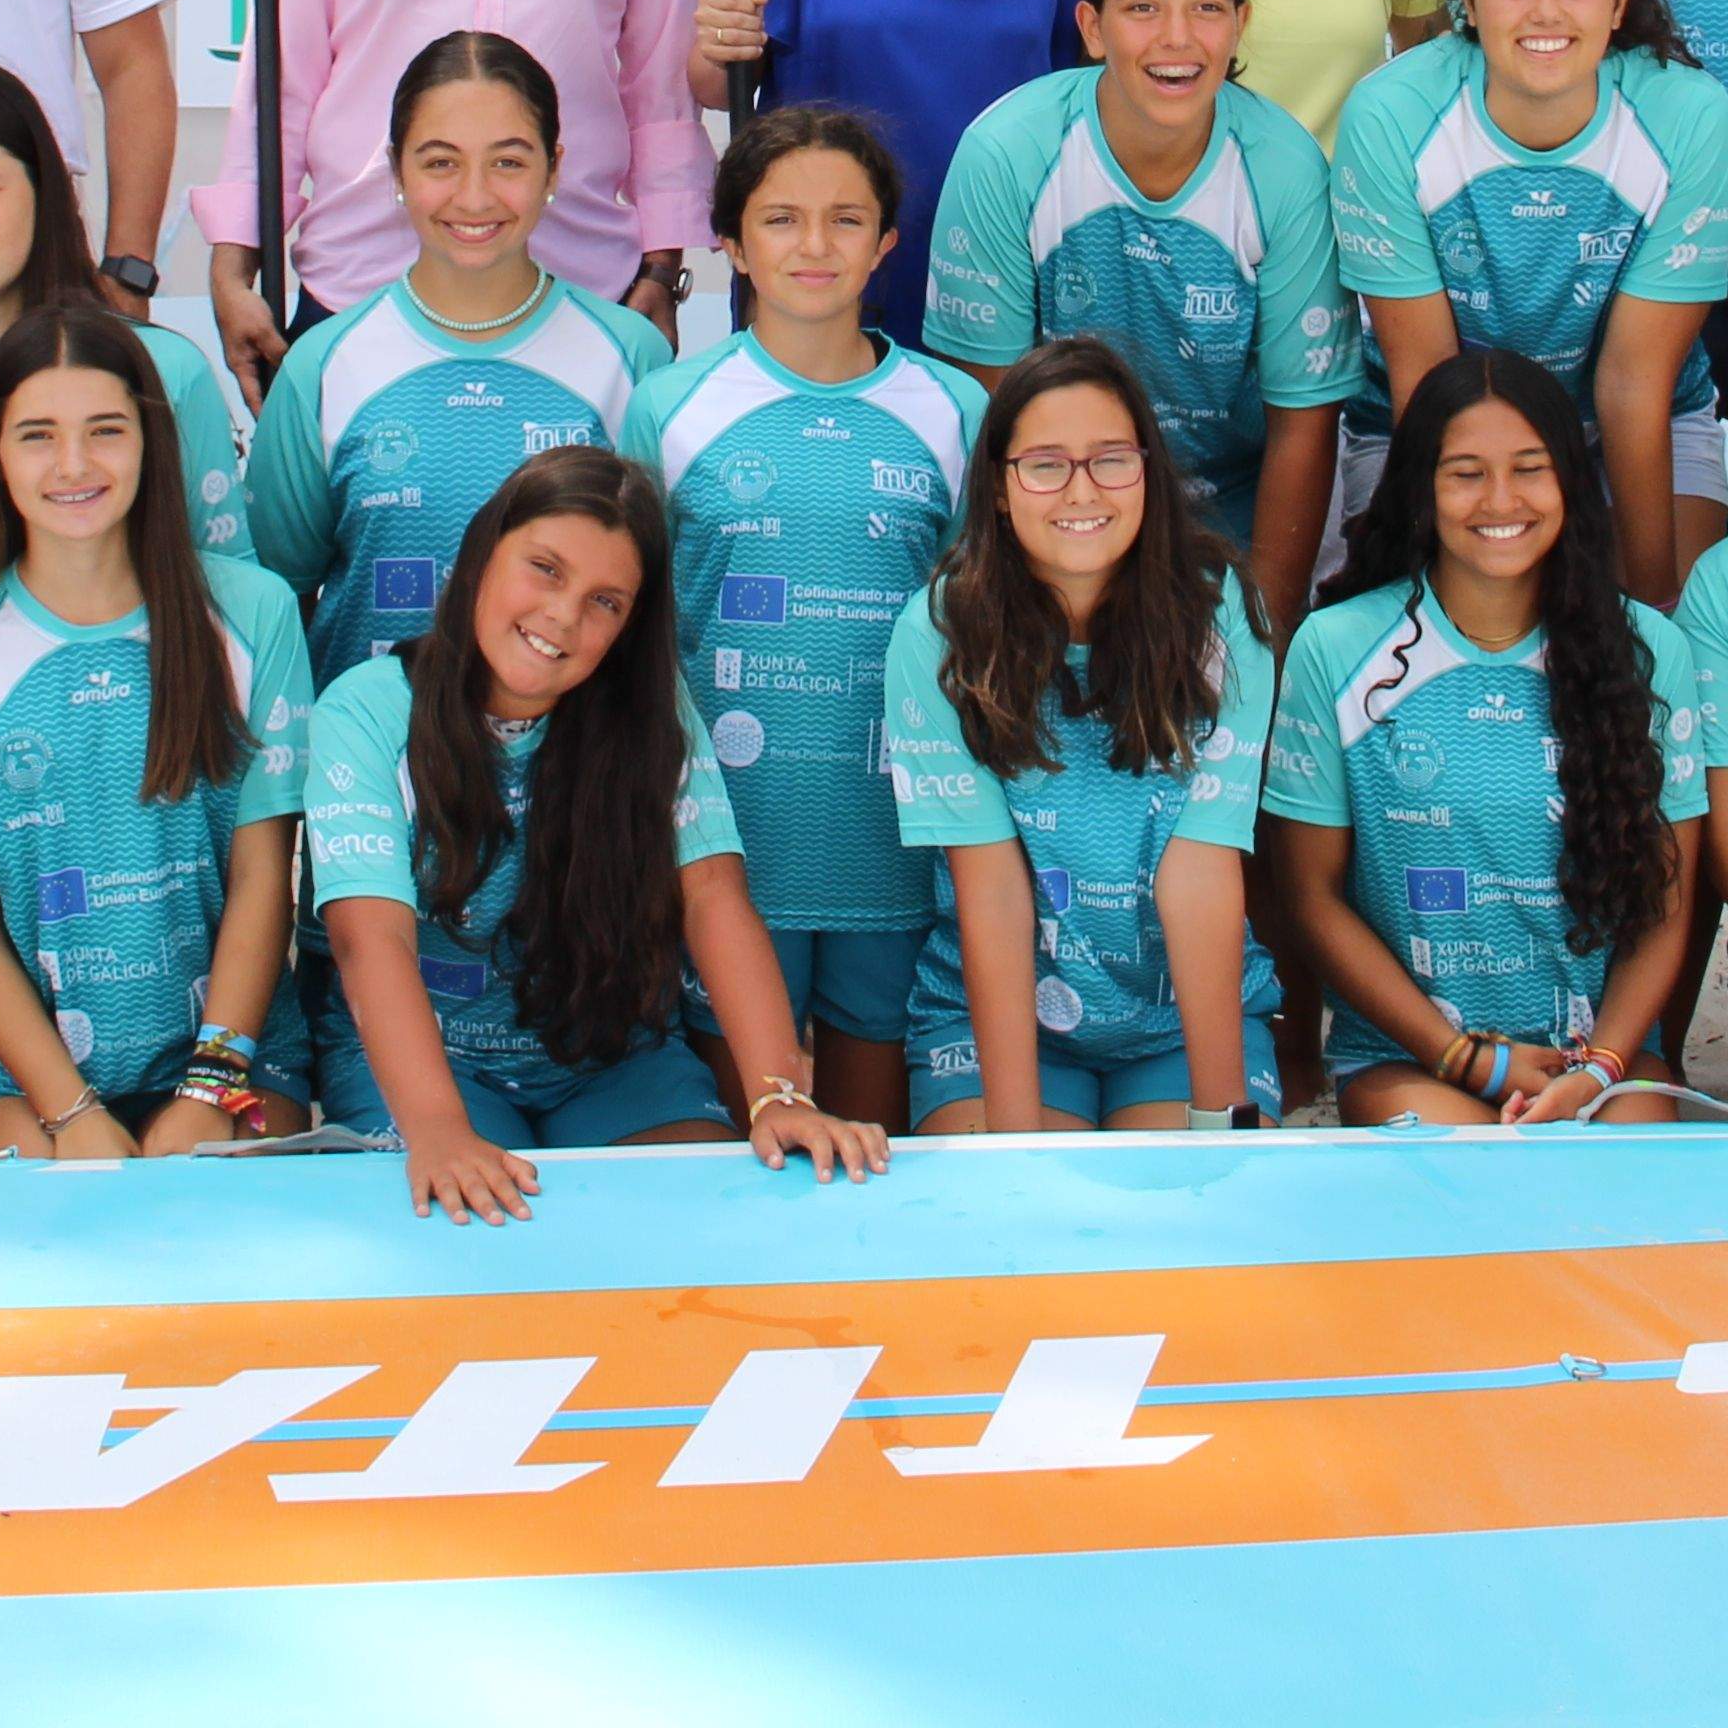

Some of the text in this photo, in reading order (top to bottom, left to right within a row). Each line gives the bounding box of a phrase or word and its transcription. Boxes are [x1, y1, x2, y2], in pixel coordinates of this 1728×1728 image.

[1510, 202, 1567, 219] amura
[1122, 243, 1173, 266] amura
[1341, 235, 1395, 258] ence
[939, 295, 998, 324] ence
[446, 394, 505, 407] amura
[801, 428, 851, 441] amura
[792, 583, 906, 606] Cofinanciado por
[792, 602, 893, 622] Unión Europea
[746, 654, 808, 672] XUNTA
[745, 672, 844, 694] DE GALICIA
[71, 683, 131, 706] amura
[1467, 705, 1524, 722] amura
[915, 772, 976, 798] ence
[327, 832, 395, 856] ence
[92, 891, 136, 909] Unión
[1076, 892, 1120, 911] Unión
[1473, 889, 1511, 906] Unión
[1436, 940, 1494, 958] XUNTA
[67, 960, 160, 986] DE GALICIA
[1435, 955, 1525, 976] DE GALICIA
[447, 1018, 509, 1036] XUNTA
[447, 1031, 469, 1047] DE
